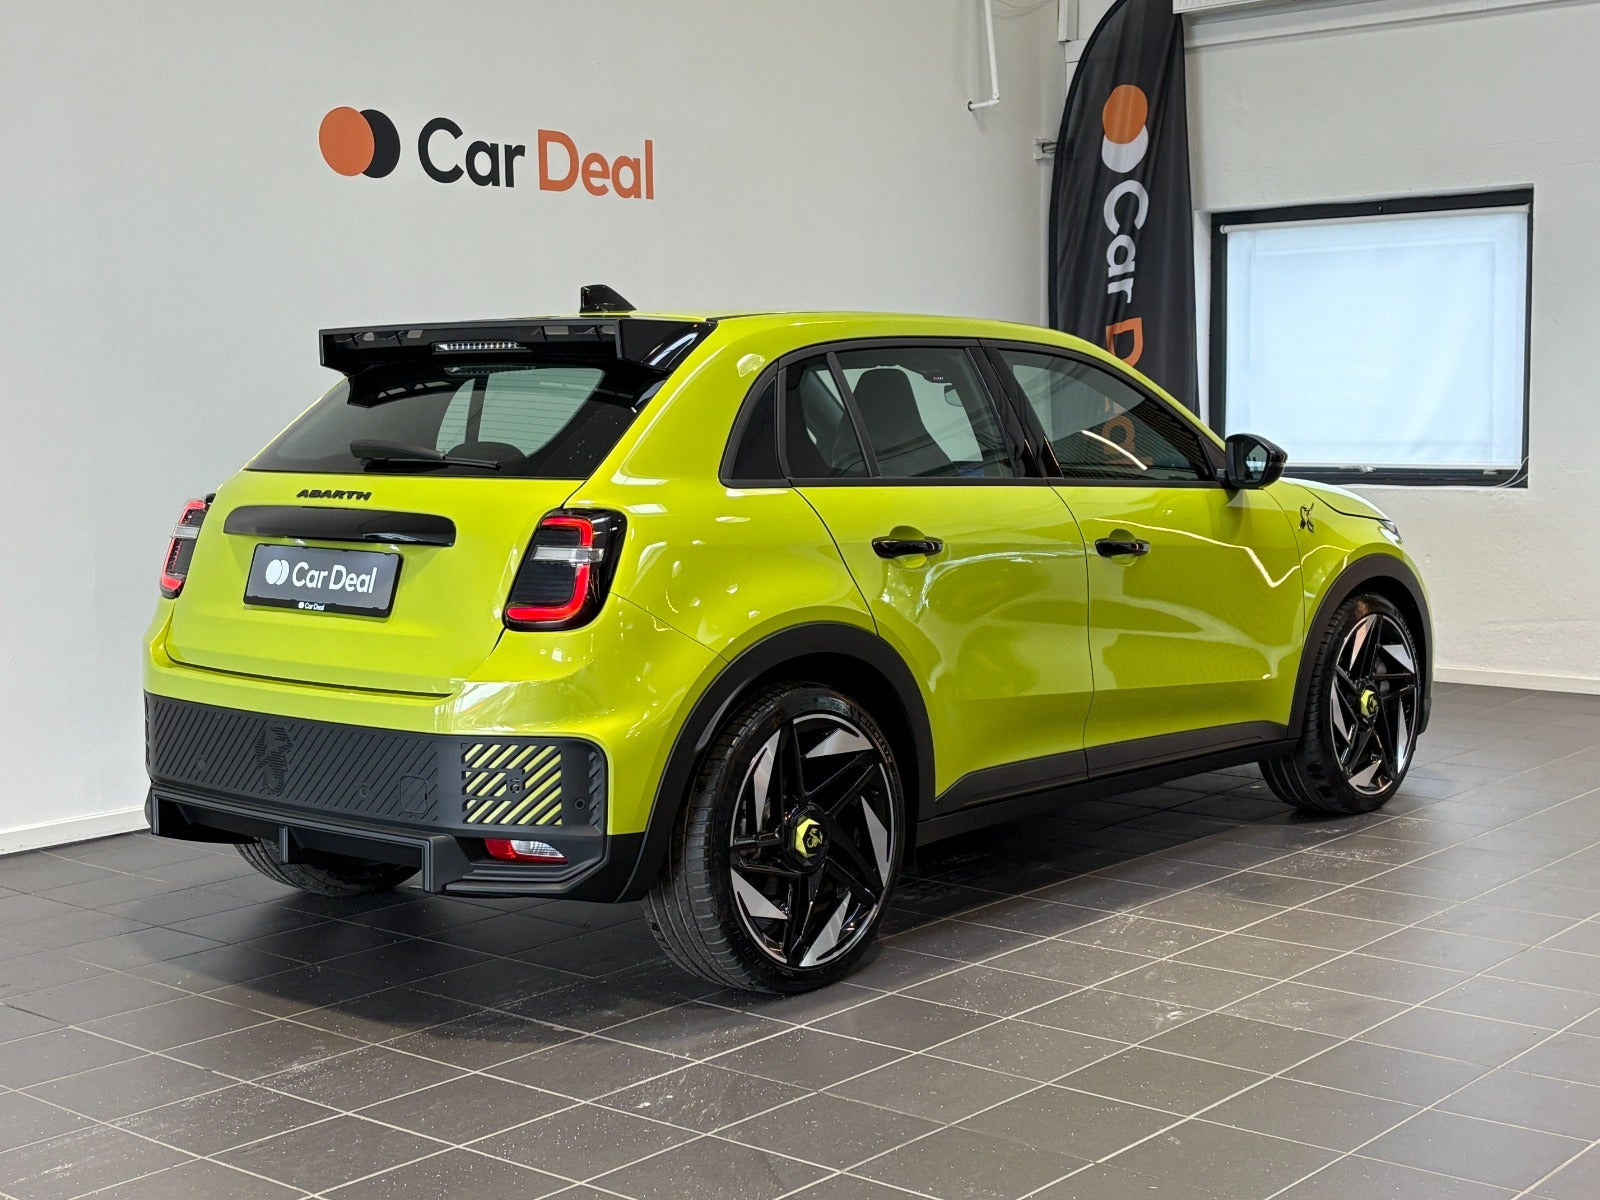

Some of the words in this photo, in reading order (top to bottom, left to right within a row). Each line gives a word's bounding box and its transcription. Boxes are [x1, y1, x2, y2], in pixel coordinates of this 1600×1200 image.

[418, 117, 526, 188] Car
[537, 128, 654, 200] Deal
[1104, 179, 1149, 303] Car
[296, 489, 372, 501] ABARTH
[292, 561, 328, 589] Car
[329, 564, 378, 594] Deal
[304, 602, 313, 610] Car
[313, 603, 325, 611] Deal
